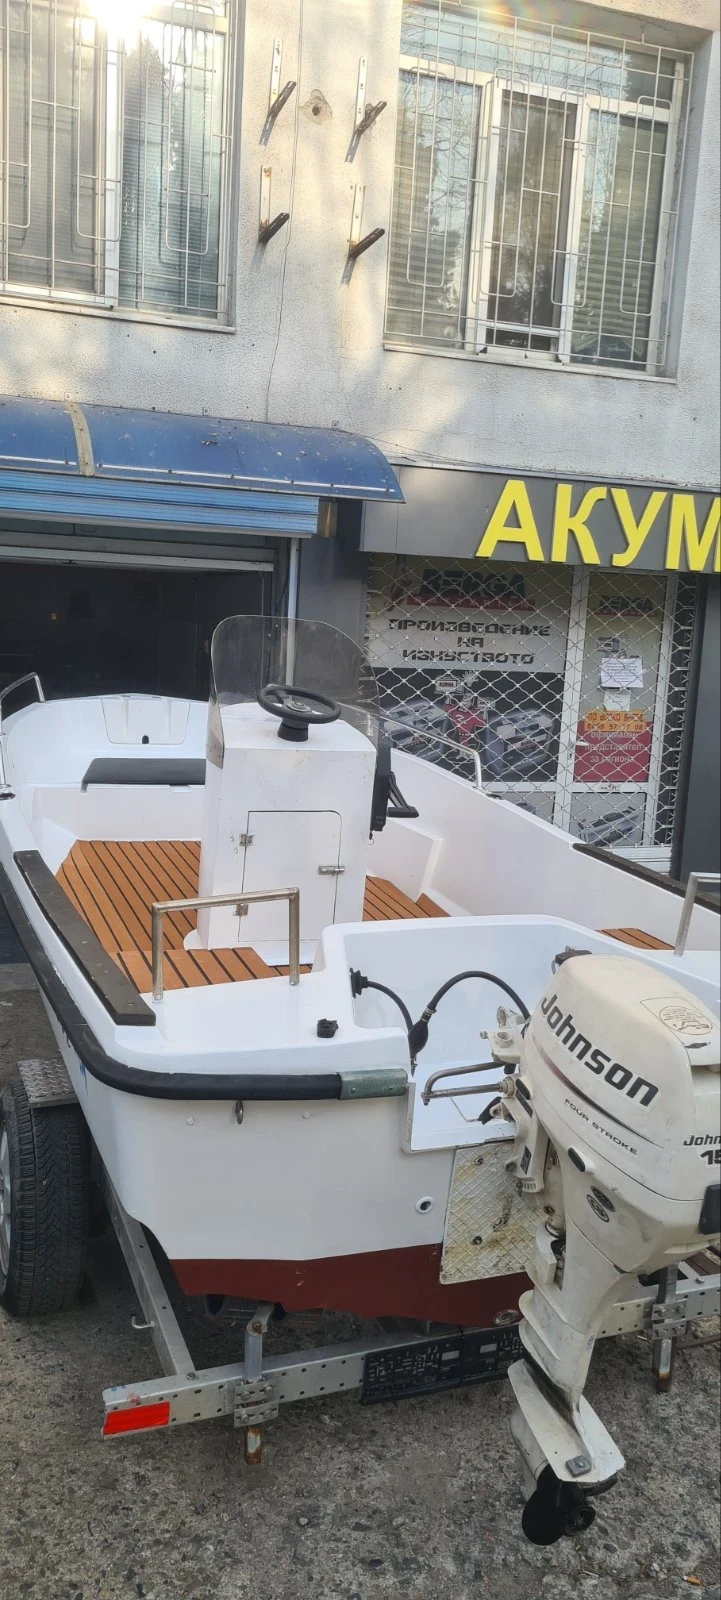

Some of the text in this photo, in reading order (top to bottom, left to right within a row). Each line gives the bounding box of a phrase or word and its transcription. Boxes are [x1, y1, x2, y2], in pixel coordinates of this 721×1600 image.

[476, 479, 720, 572] АКУМ
[389, 619, 551, 636] ПРОИЗВЕДЕНИЕ
[457, 637, 484, 648] НА
[540, 994, 659, 1107] Johnson
[564, 1098, 638, 1156] FOUR STROKE
